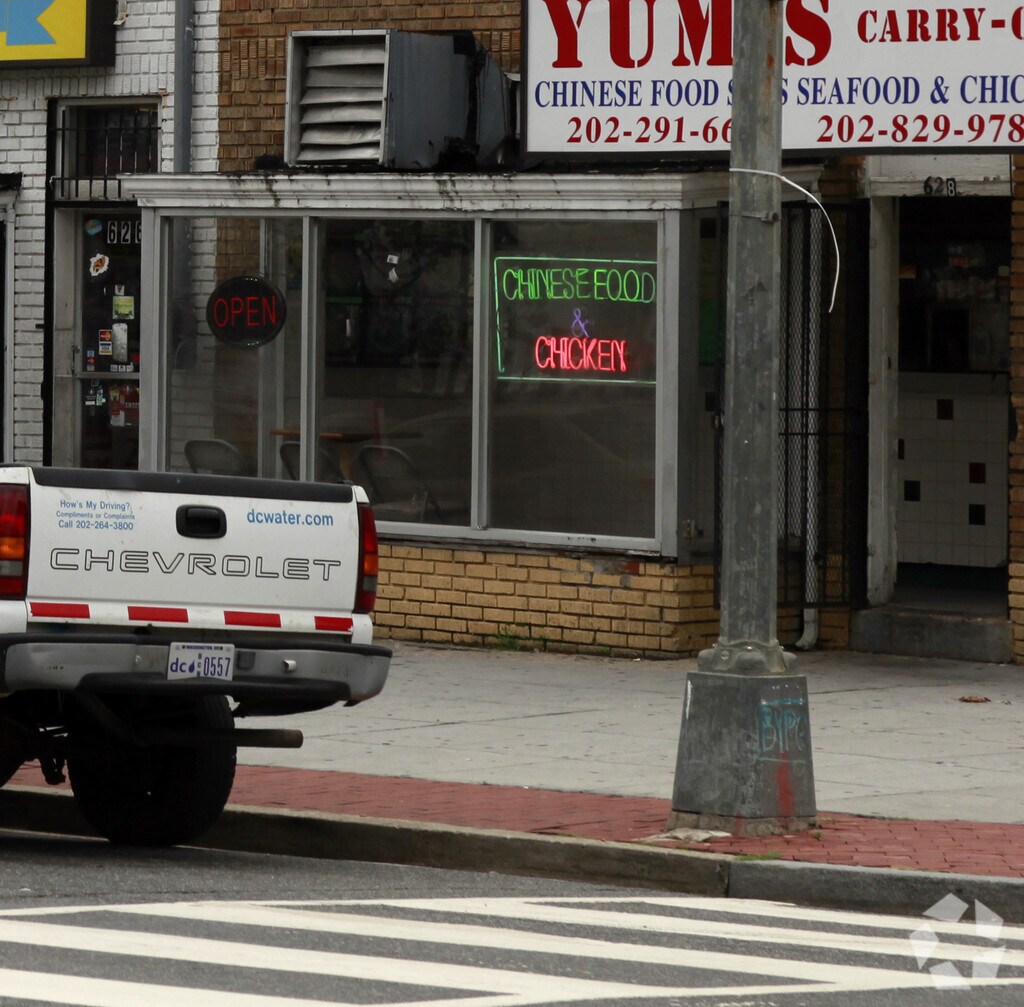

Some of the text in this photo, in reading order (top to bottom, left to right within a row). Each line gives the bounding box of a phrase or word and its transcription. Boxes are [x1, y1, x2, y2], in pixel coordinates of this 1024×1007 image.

[534, 79, 643, 108] CHINESE
[651, 78, 719, 107] FOOD
[797, 76, 920, 106] SEAFOOD
[929, 76, 950, 104] &
[924, 176, 956, 197] 628
[502, 267, 656, 304] CHINESE FOOD
[213, 295, 277, 328] OPEN
[571, 307, 589, 338] &
[535, 335, 627, 372] CHICKEN
[56, 510, 93, 519] Compliments
[103, 512, 136, 520] Complaints
[60, 499, 131, 512] How's My Driving?
[246, 508, 334, 527] dcwater.com
[58, 519, 134, 531] Call 202-264-3800
[50, 547, 341, 582] CHEVROLET
[203, 656, 231, 677] 0557
